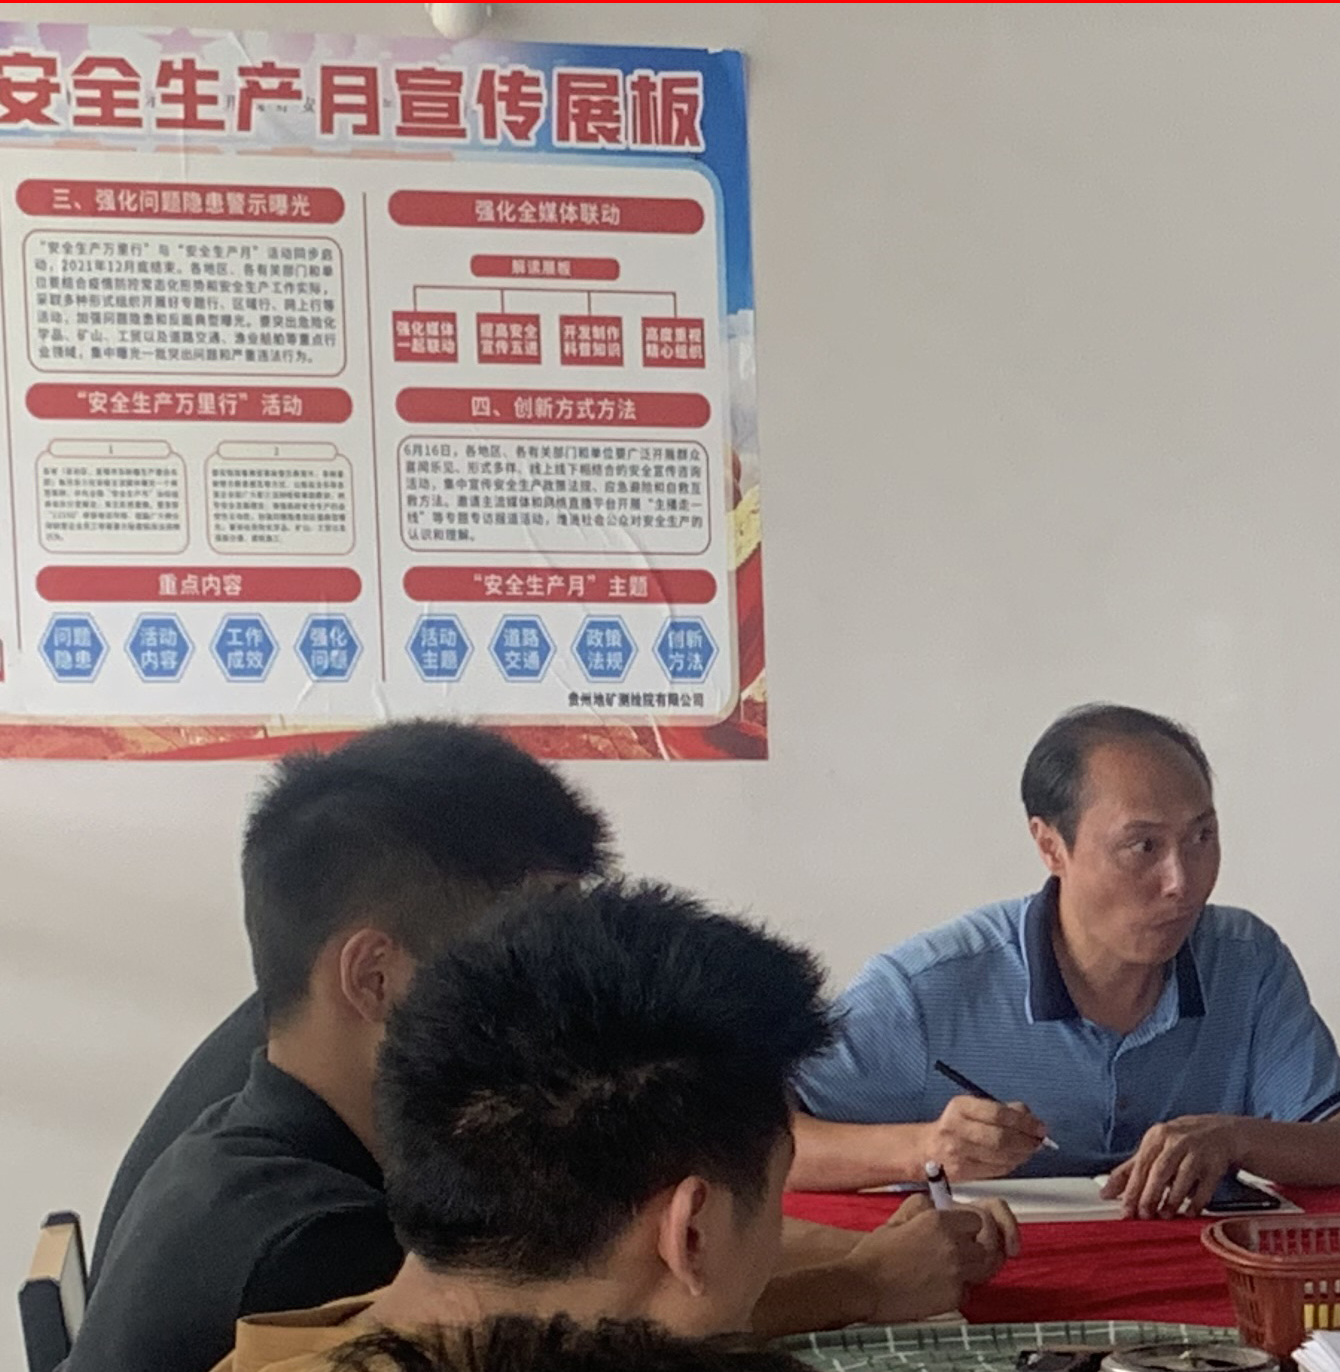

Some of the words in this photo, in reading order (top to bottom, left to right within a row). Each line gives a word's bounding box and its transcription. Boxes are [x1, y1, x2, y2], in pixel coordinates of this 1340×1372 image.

[0, 52, 703, 147] 安全生产月宣传展板
[51, 187, 312, 217] 三、强化问题隐患警示曝光
[474, 199, 622, 225] 强化全媒体联动
[77, 391, 304, 416] “安全生产万里行”活动
[470, 396, 638, 421] 四、创新方式方法
[157, 573, 243, 597] 重点内容
[473, 572, 649, 598] “安全生产月”主题
[53, 626, 92, 648] 问题
[139, 627, 178, 647] 活动
[226, 627, 263, 647] 工作
[309, 627, 349, 648] 强化
[420, 627, 458, 648] 活动
[503, 627, 540, 648] 道路
[586, 627, 623, 648] 政策
[53, 649, 93, 670] 隐患
[139, 649, 178, 670] 内容
[226, 649, 264, 670] 成效
[311, 649, 349, 670] 问题
[421, 649, 458, 670] 主题
[504, 650, 541, 671] 交通
[586, 650, 623, 671] 法规
[668, 651, 704, 672] 方法
